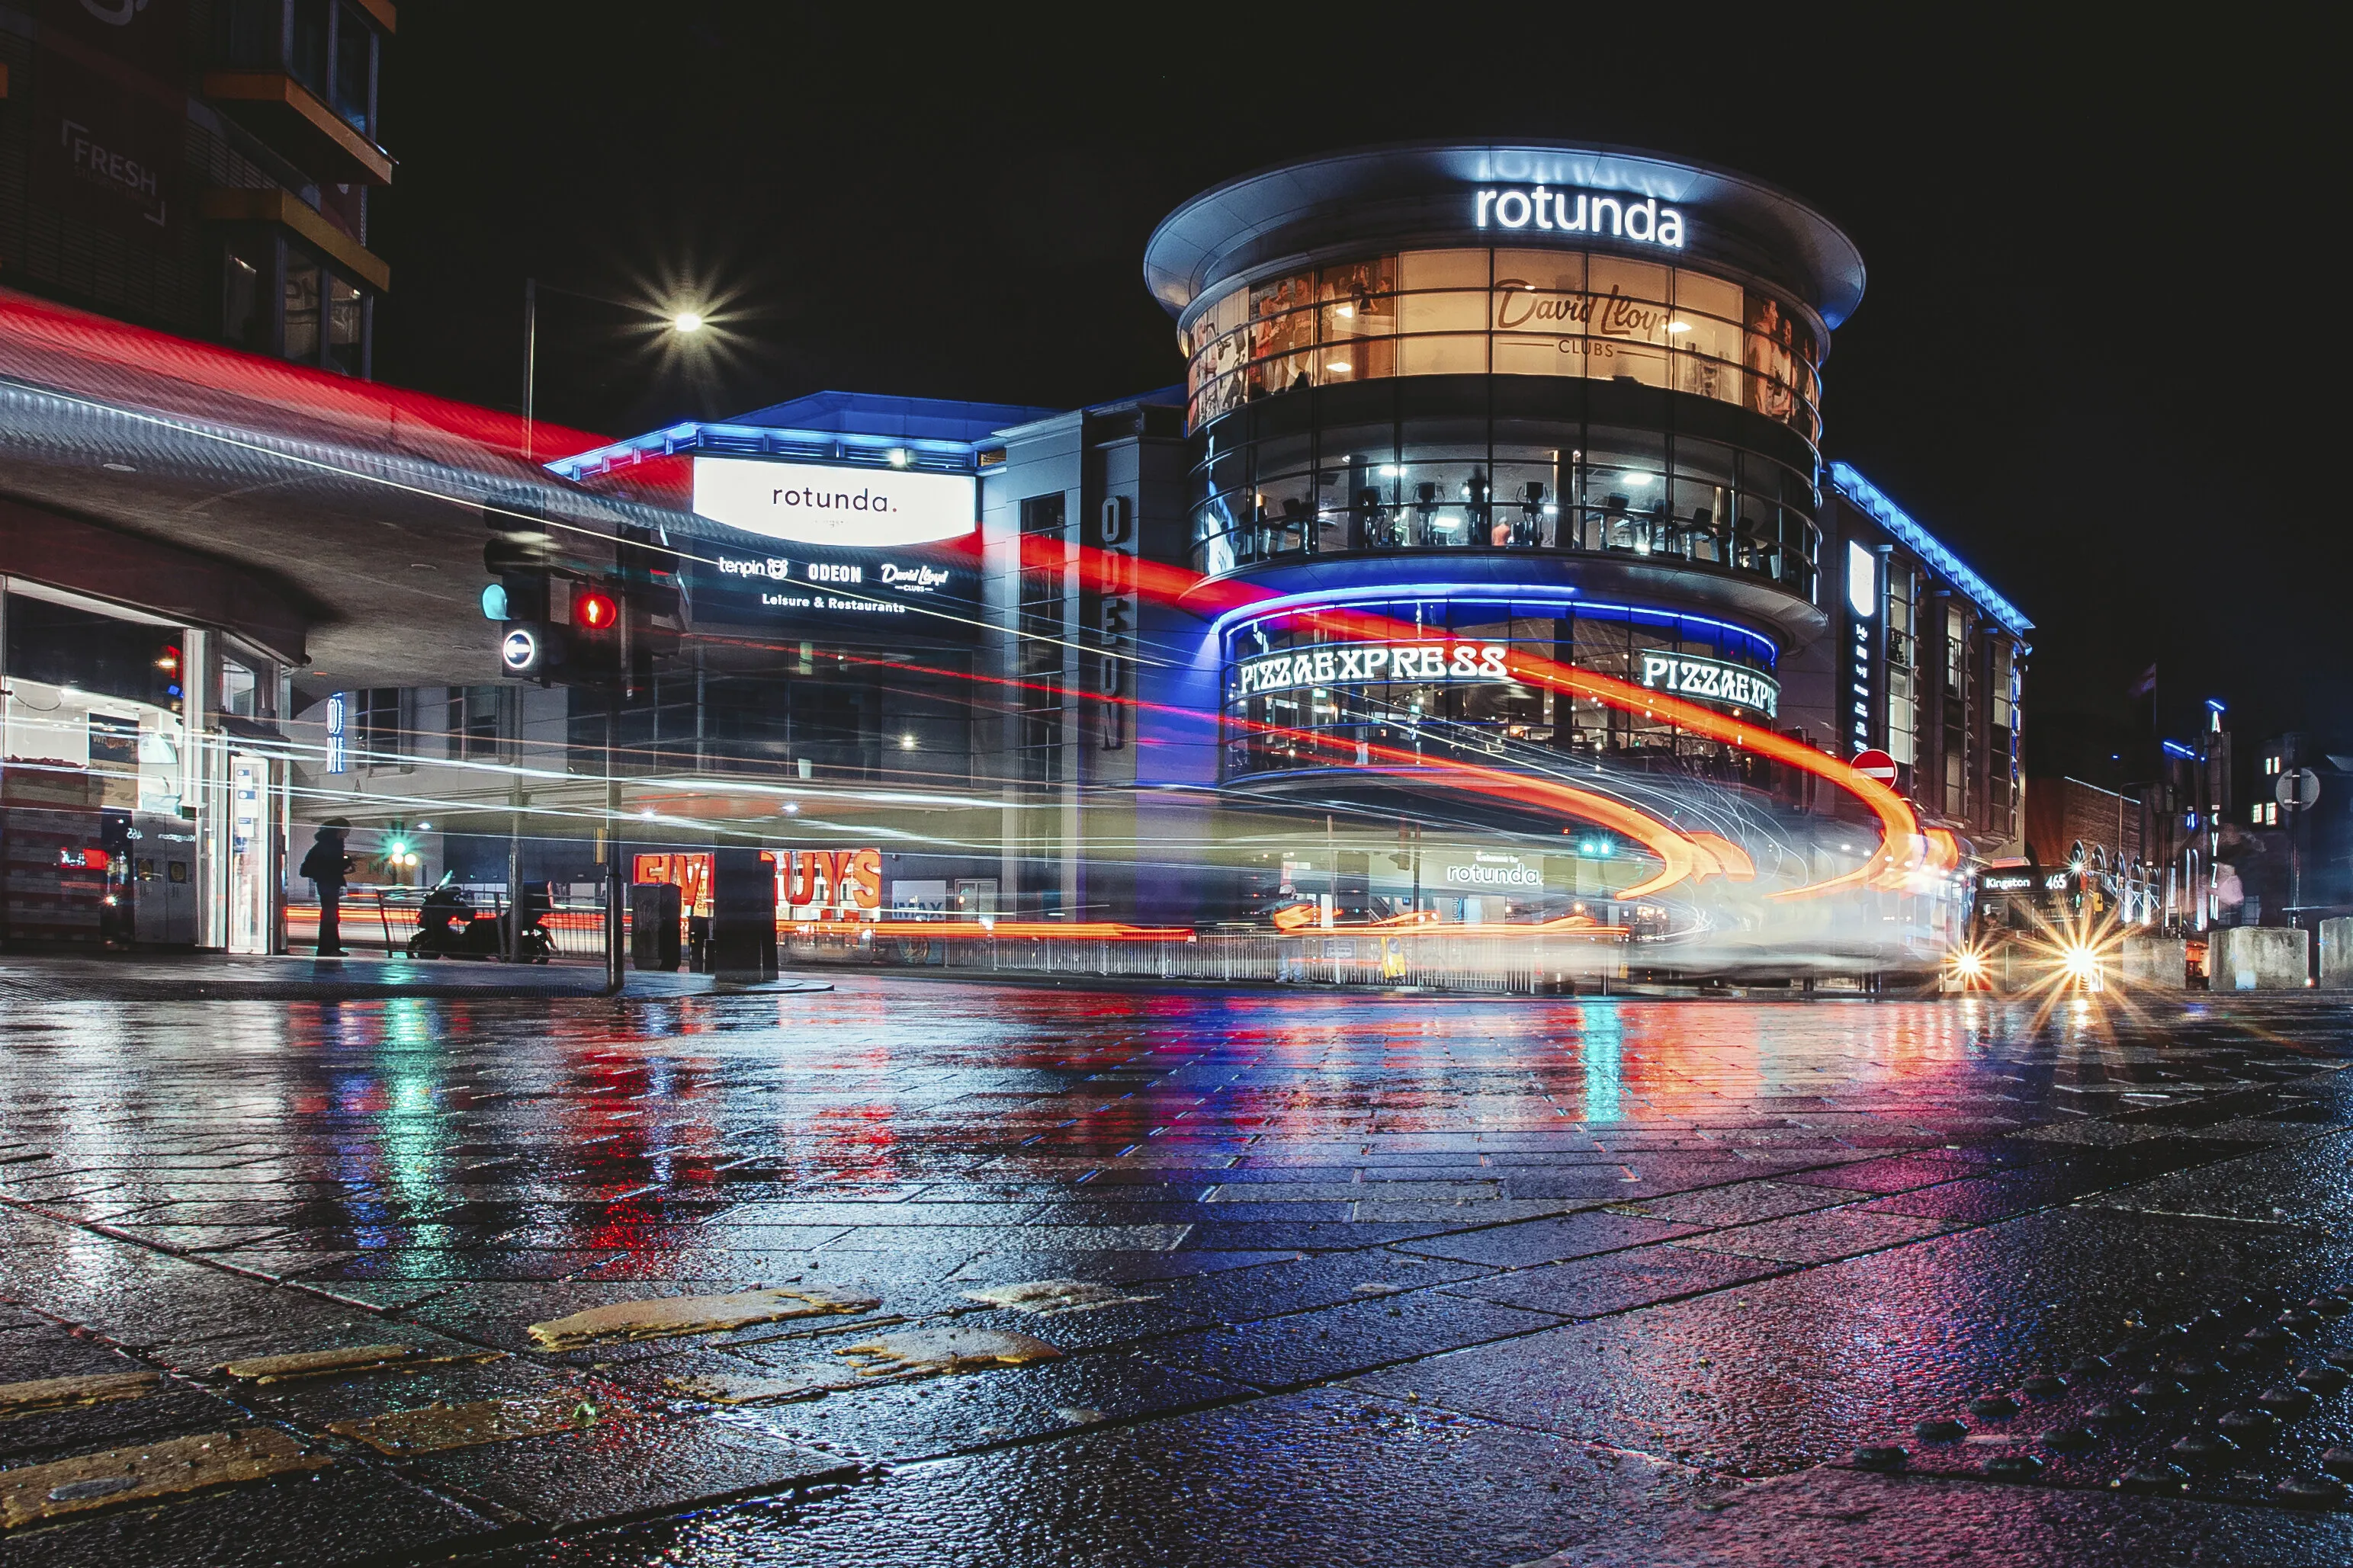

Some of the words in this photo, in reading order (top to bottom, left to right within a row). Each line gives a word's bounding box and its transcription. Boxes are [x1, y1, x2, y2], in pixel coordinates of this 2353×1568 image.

[74, 137, 157, 197] FRESH
[1476, 185, 1682, 248] rotunda
[1495, 279, 1597, 329] David
[1558, 339, 1613, 358] CLUBS
[773, 487, 897, 512] rotunda.
[719, 556, 765, 577] tenpin
[808, 563, 862, 582] ODEON
[881, 564, 919, 583] David
[916, 566, 949, 585] Lloyd
[762, 594, 810, 607] Leisure
[814, 597, 825, 608] &
[829, 598, 906, 613] Restaurants
[1099, 497, 1122, 749] ODEON
[1241, 646, 1507, 694] PIZZAEXPRESS
[1985, 877, 2030, 890] Kingston
[2045, 874, 2067, 890] 465
[894, 902, 942, 919] IMAX
